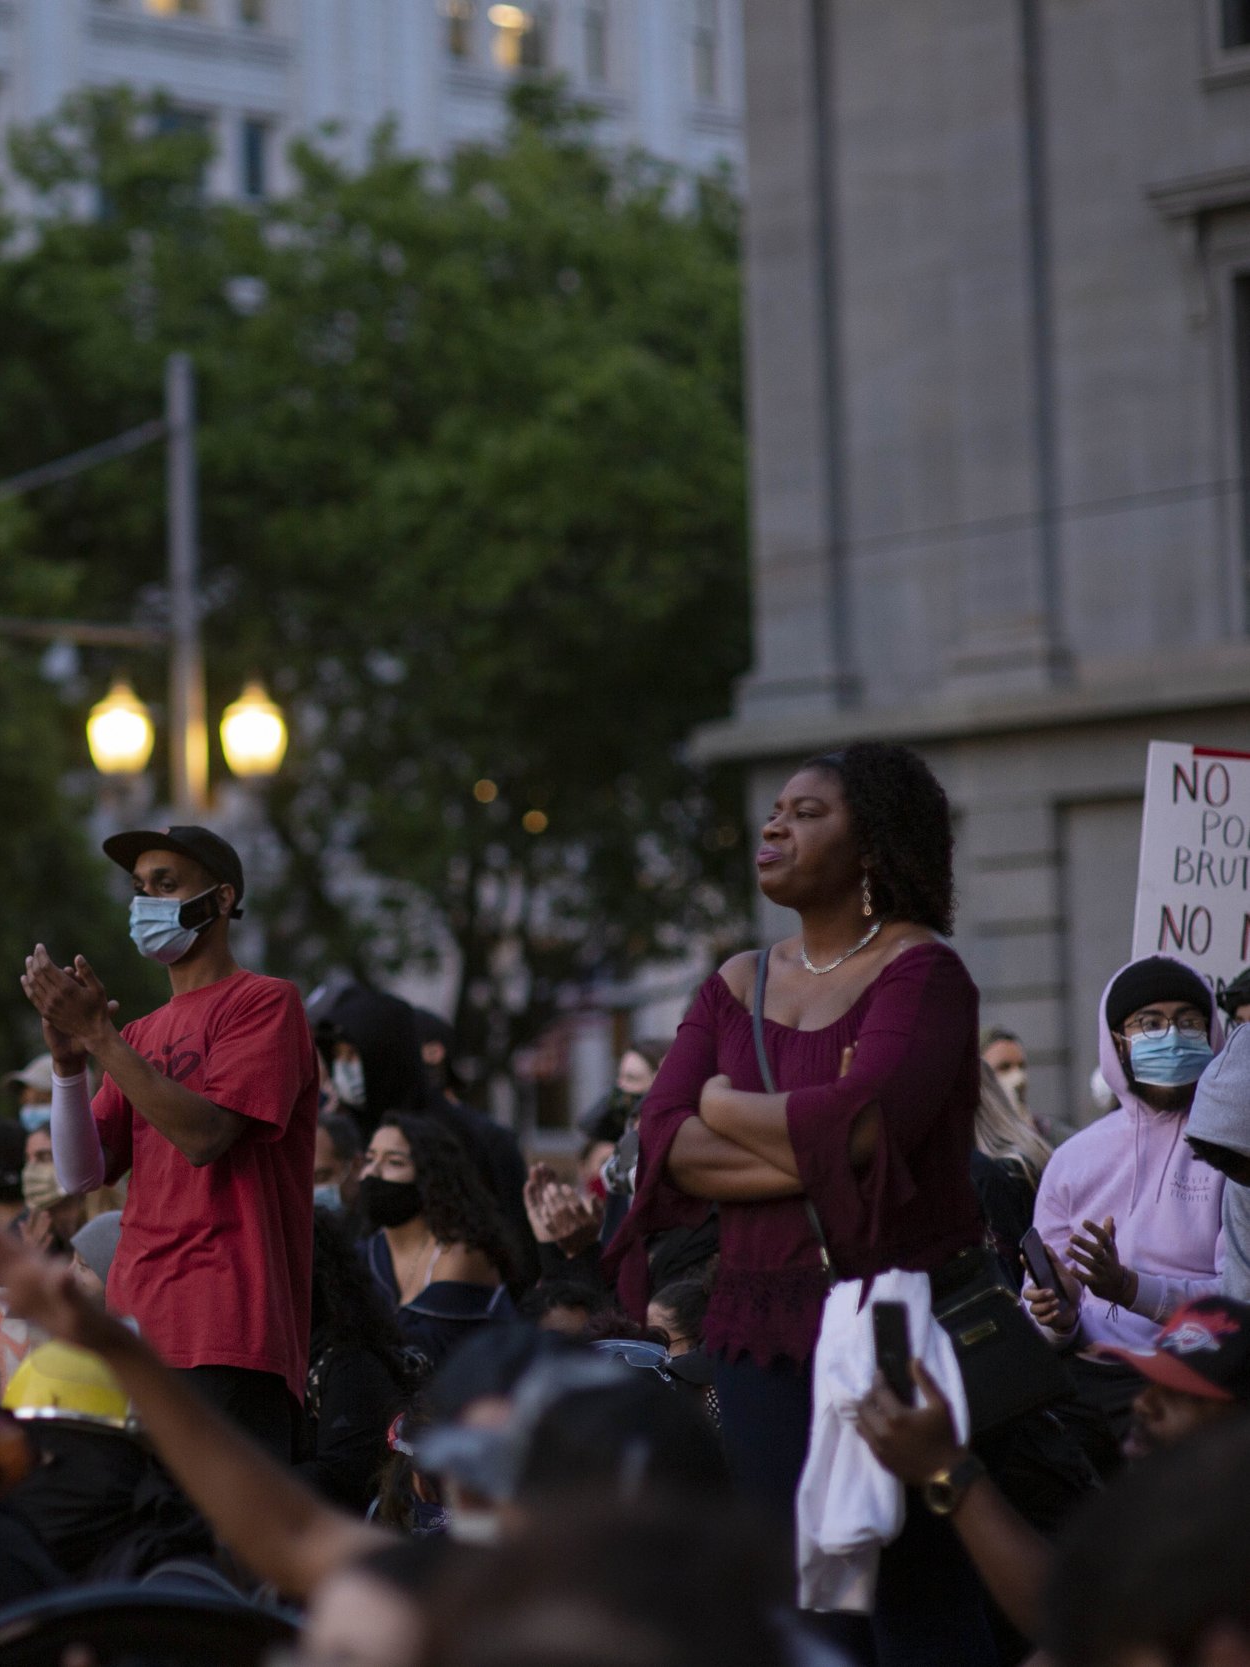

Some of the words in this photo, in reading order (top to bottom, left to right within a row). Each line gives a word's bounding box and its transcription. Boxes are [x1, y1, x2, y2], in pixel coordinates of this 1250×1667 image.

[1172, 761, 1230, 807] NO
[1201, 810, 1250, 849] PO
[1158, 903, 1212, 955] NO
[1170, 1189, 1210, 1203] FIGHTER
